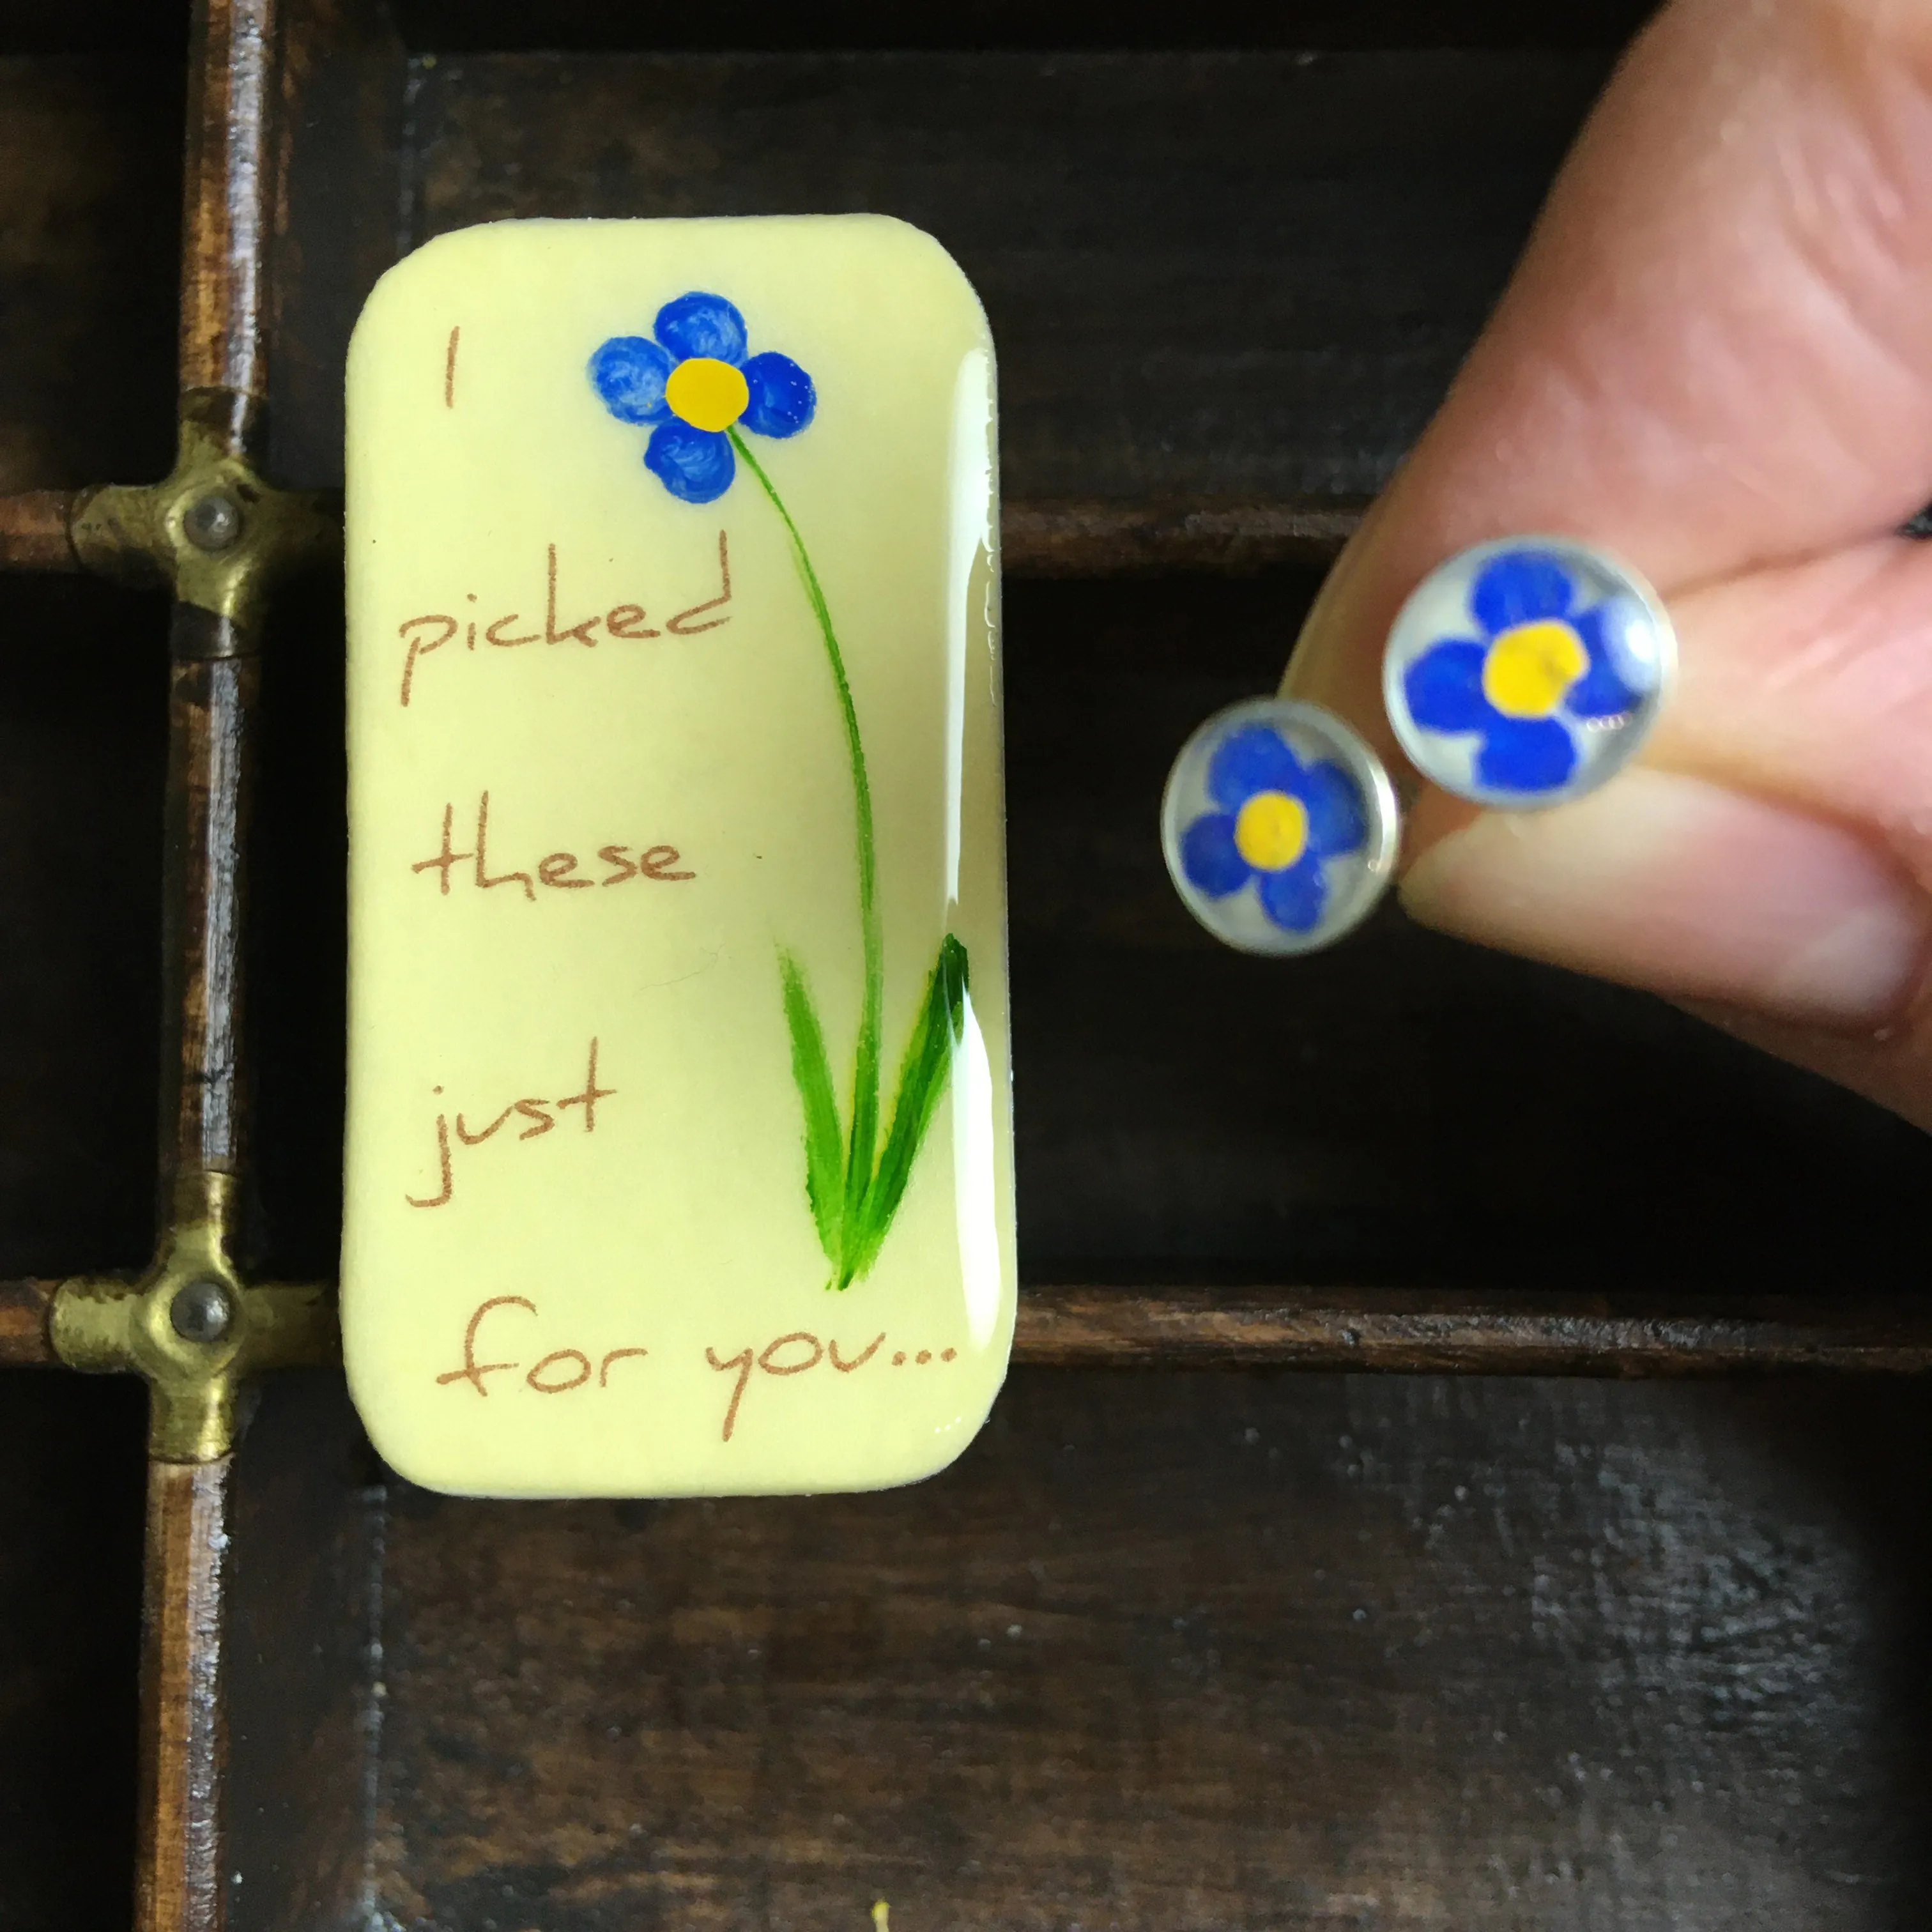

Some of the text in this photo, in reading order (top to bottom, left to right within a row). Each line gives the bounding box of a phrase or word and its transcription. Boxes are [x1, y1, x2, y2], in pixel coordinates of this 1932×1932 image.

[445, 325, 460, 408] I
[399, 529, 732, 706] picked
[412, 790, 696, 901] these
[406, 1036, 617, 1208] just
[438, 1295, 957, 1442] for you...
